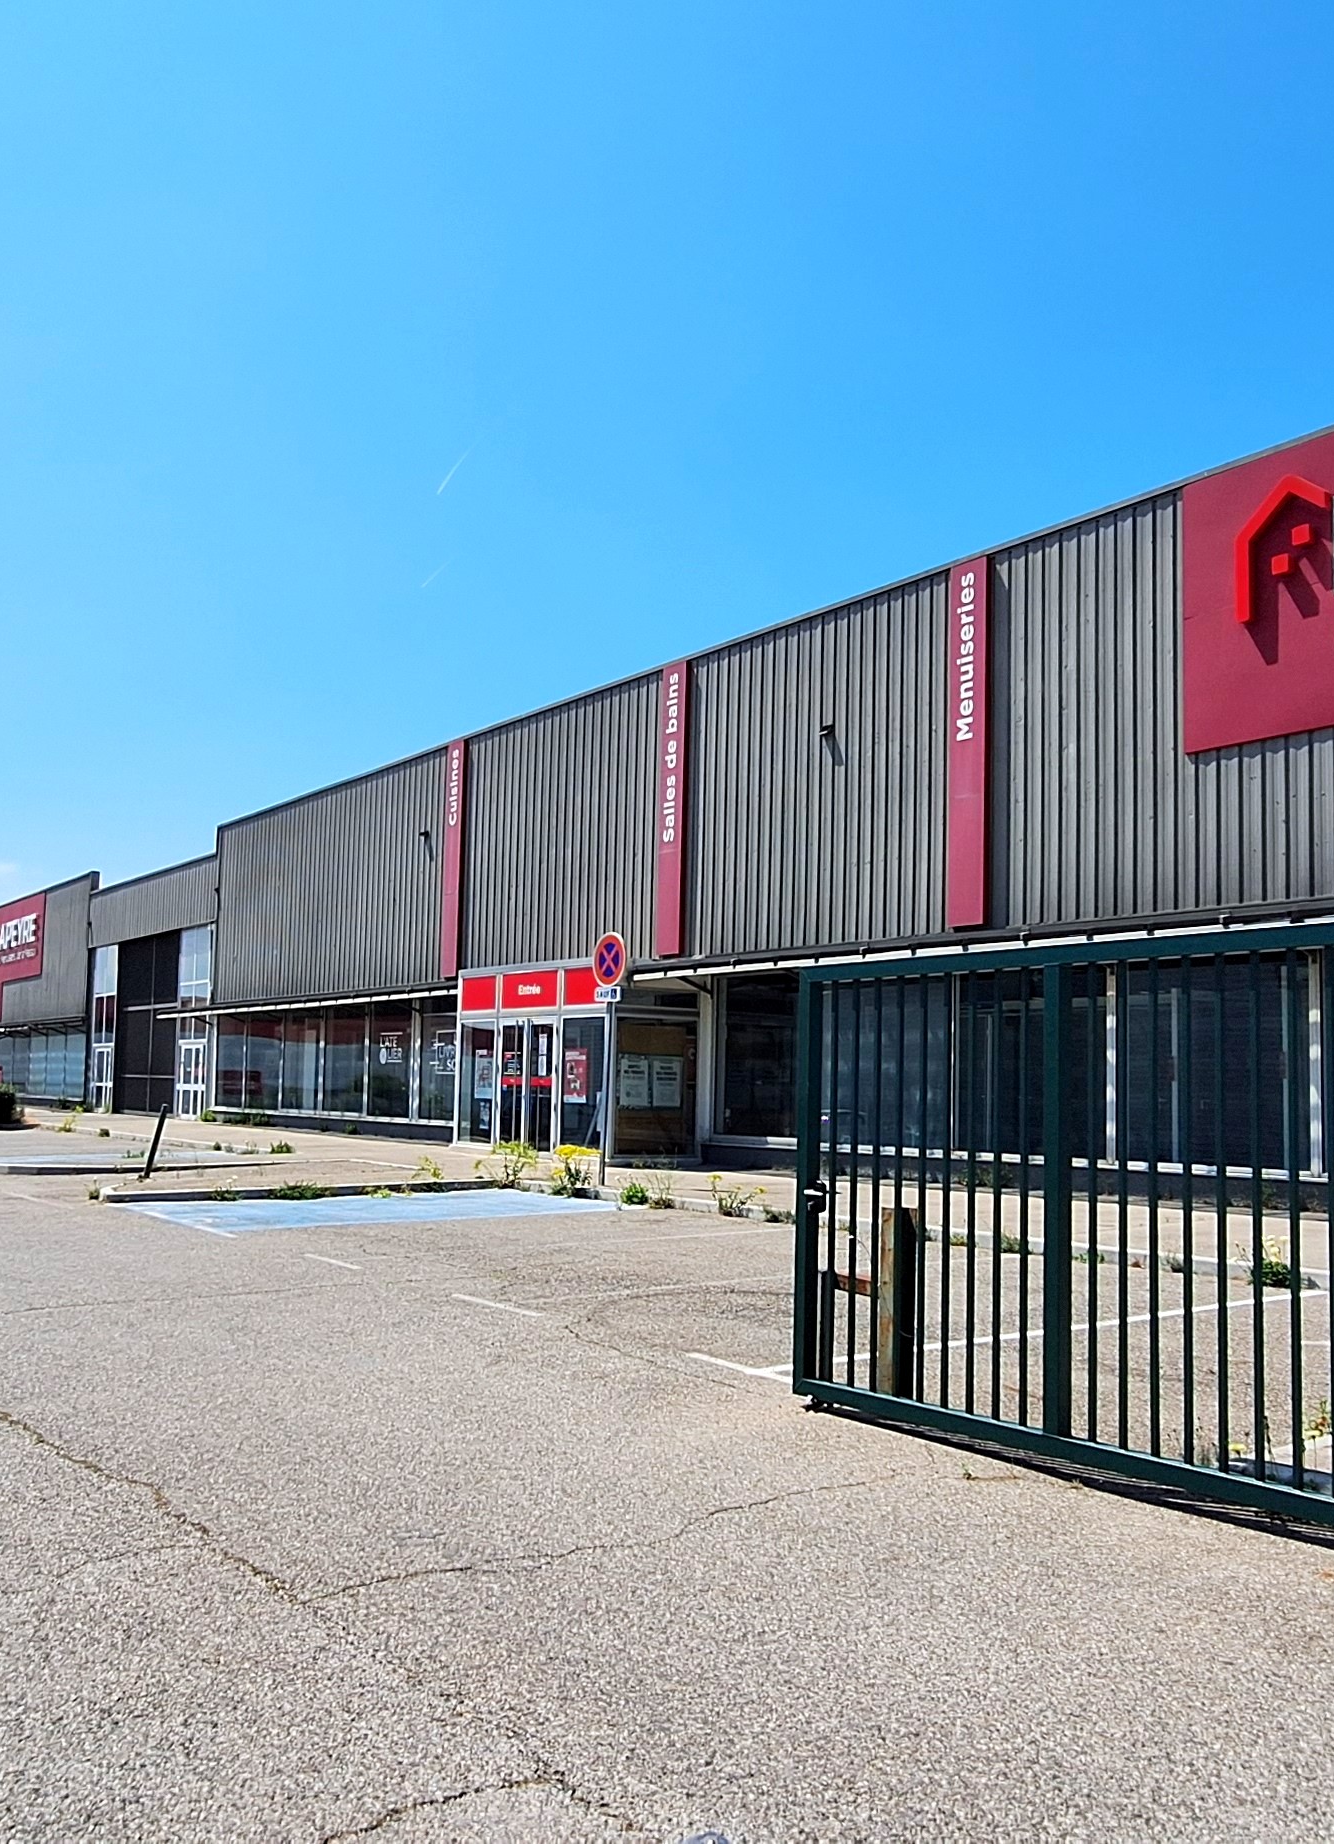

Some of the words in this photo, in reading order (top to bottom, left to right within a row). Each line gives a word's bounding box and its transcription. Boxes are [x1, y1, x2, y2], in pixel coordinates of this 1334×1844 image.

[955, 571, 976, 742] Menuiseries
[665, 672, 680, 734] bains
[664, 739, 678, 769] de
[448, 748, 460, 827] Cuisines
[662, 775, 677, 843] Salles
[517, 983, 542, 996] Entrée
